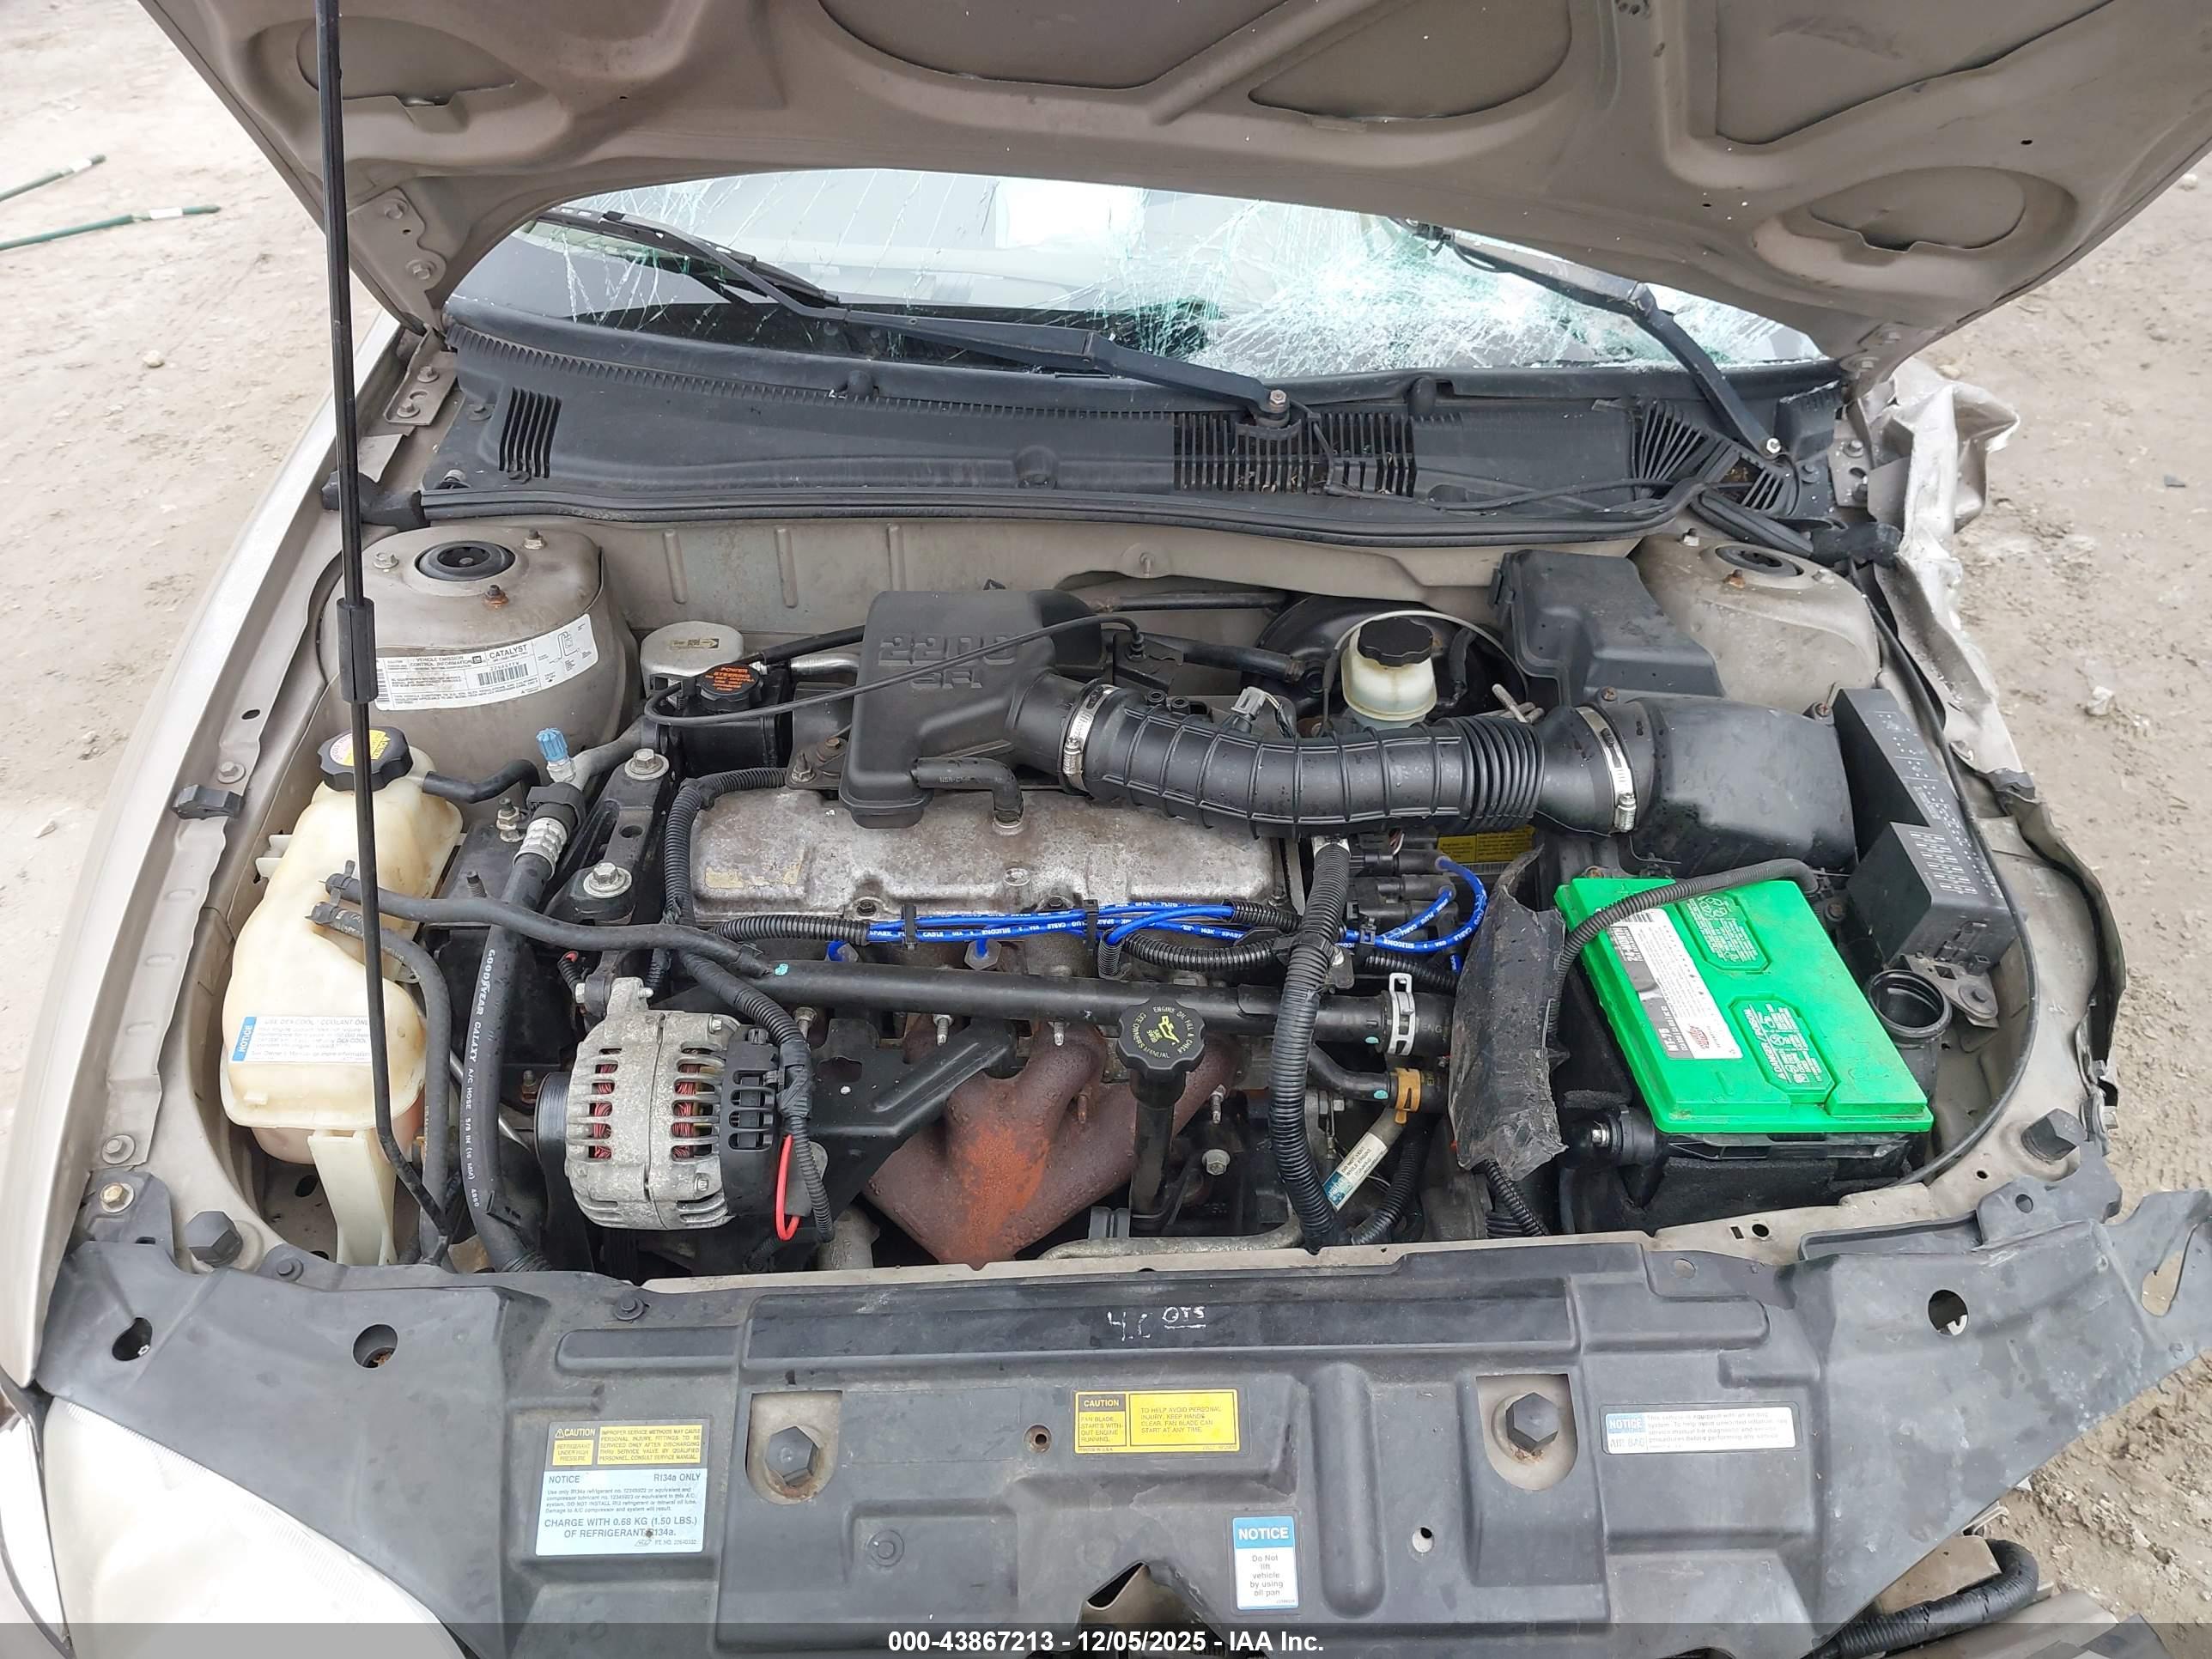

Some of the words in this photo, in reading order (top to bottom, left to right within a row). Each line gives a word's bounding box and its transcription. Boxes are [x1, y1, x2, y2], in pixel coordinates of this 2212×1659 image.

[489, 644, 527, 659] CATALYST
[1383, 939, 1415, 949] SILICONE
[476, 949, 495, 1017] GOODYEAR
[1152, 1006, 1176, 1014] ENGINE
[1176, 1011, 1187, 1020] OIL
[1185, 1019, 1195, 1031] FILL
[1743, 1008, 1764, 1037] POISON
[238, 1024, 253, 1053] NOTICE
[469, 1021, 483, 1064] GALAXY
[1142, 1046, 1171, 1059] MANUAL
[1084, 1399, 1120, 1407] CAUTION
[1609, 1418, 1643, 1431] NOTICE
[564, 1428, 596, 1437] CAUTION
[549, 1475, 580, 1484] NOTICE
[653, 1474, 677, 1482] R134a
[679, 1473, 702, 1481] ONLY
[544, 1518, 584, 1528] CHARGE
[586, 1517, 611, 1527] WITH
[613, 1517, 631, 1526] 0.68
[634, 1517, 647, 1526] KG
[651, 1516, 672, 1528] (1.50
[673, 1516, 697, 1527] LBS.)
[563, 1529, 578, 1538] OF
[580, 1528, 646, 1538] REFRIGERANT
[1238, 1527, 1290, 1540] NOTICE
[1265, 1553, 1279, 1562] Not
[1250, 1581, 1260, 1589] by
